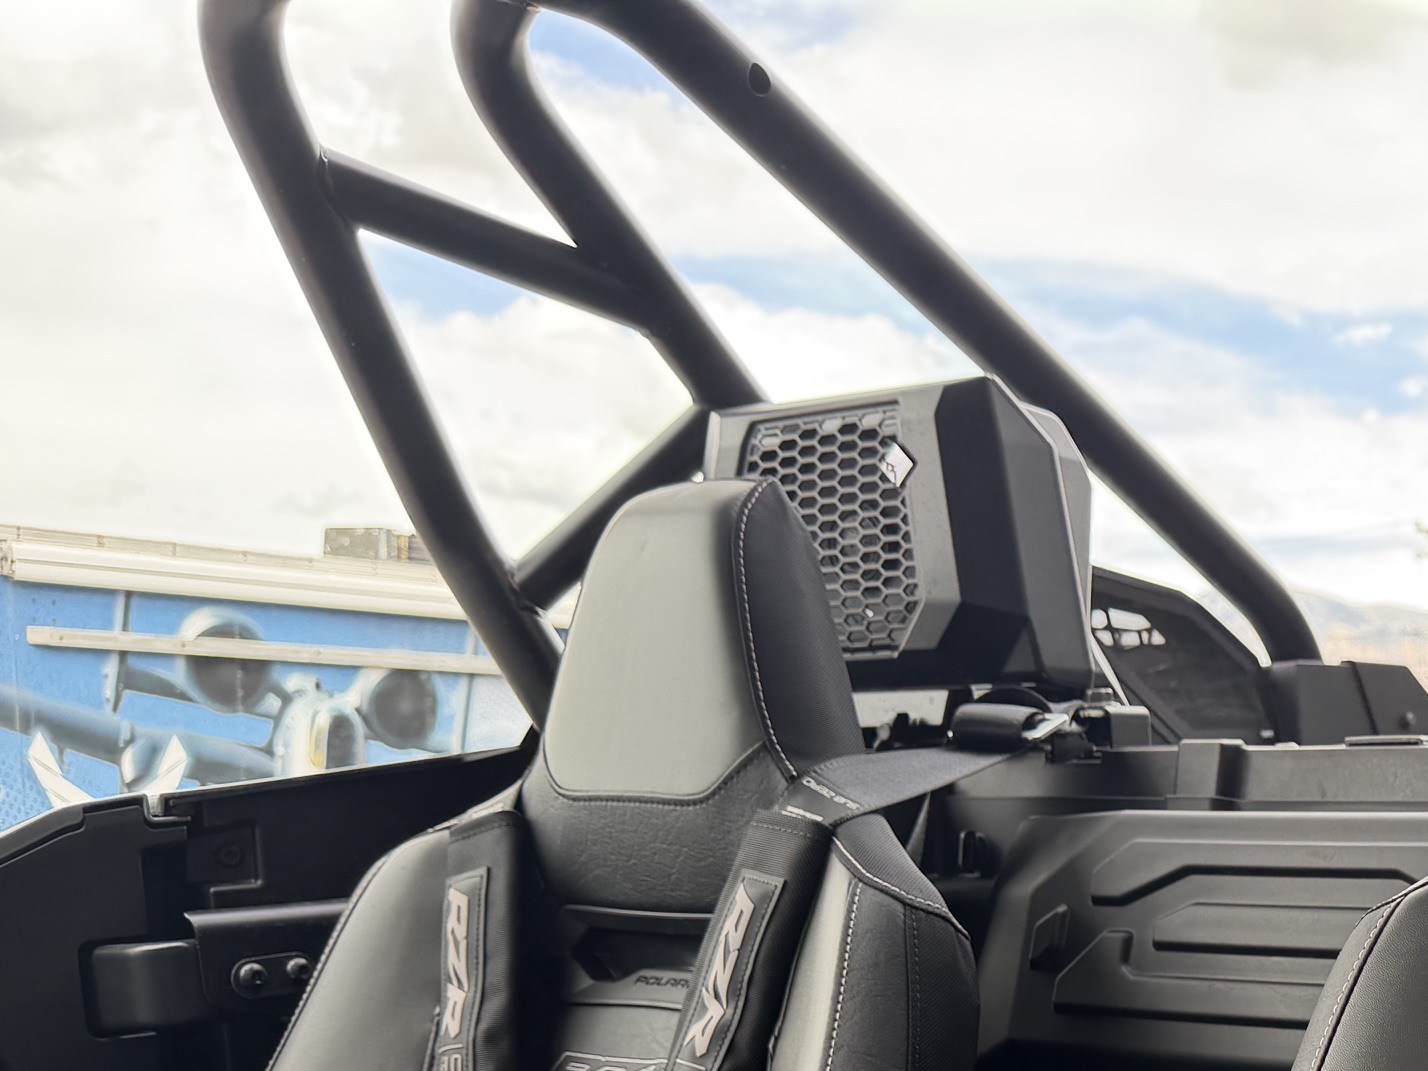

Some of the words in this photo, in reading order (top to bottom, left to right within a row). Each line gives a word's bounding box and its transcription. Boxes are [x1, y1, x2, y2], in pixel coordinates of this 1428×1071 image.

[440, 887, 469, 1039] RZR
[634, 975, 690, 989] POLAR
[683, 883, 755, 1058] RZR
